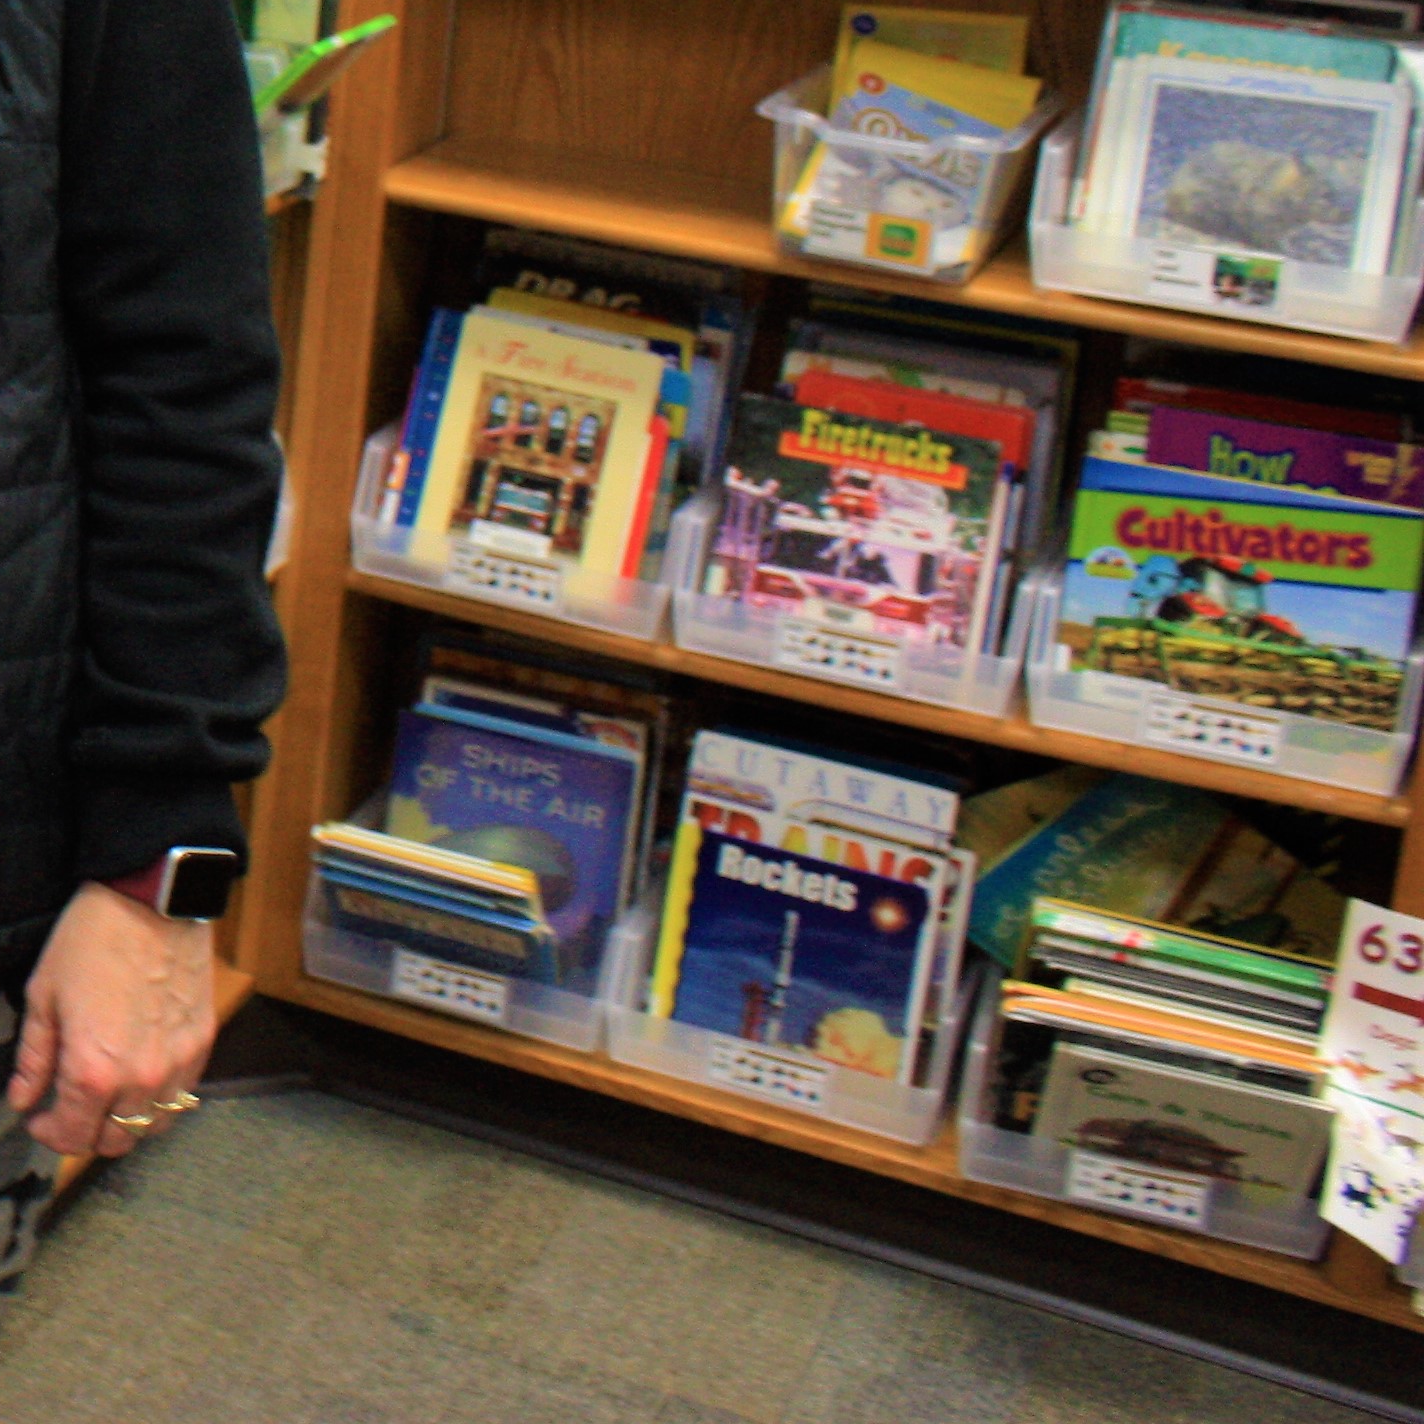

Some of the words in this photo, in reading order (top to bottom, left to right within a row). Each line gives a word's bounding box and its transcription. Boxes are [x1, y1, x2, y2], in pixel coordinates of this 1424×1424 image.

[800, 408, 953, 474] Firetrucks
[1115, 507, 1373, 569] Cultivators
[417, 762, 458, 789] OF
[469, 776, 536, 812] THE
[545, 795, 605, 829] AIR
[462, 742, 561, 787] SHIPS
[702, 739, 951, 824] CUTAWAY
[716, 842, 860, 911] Rockets
